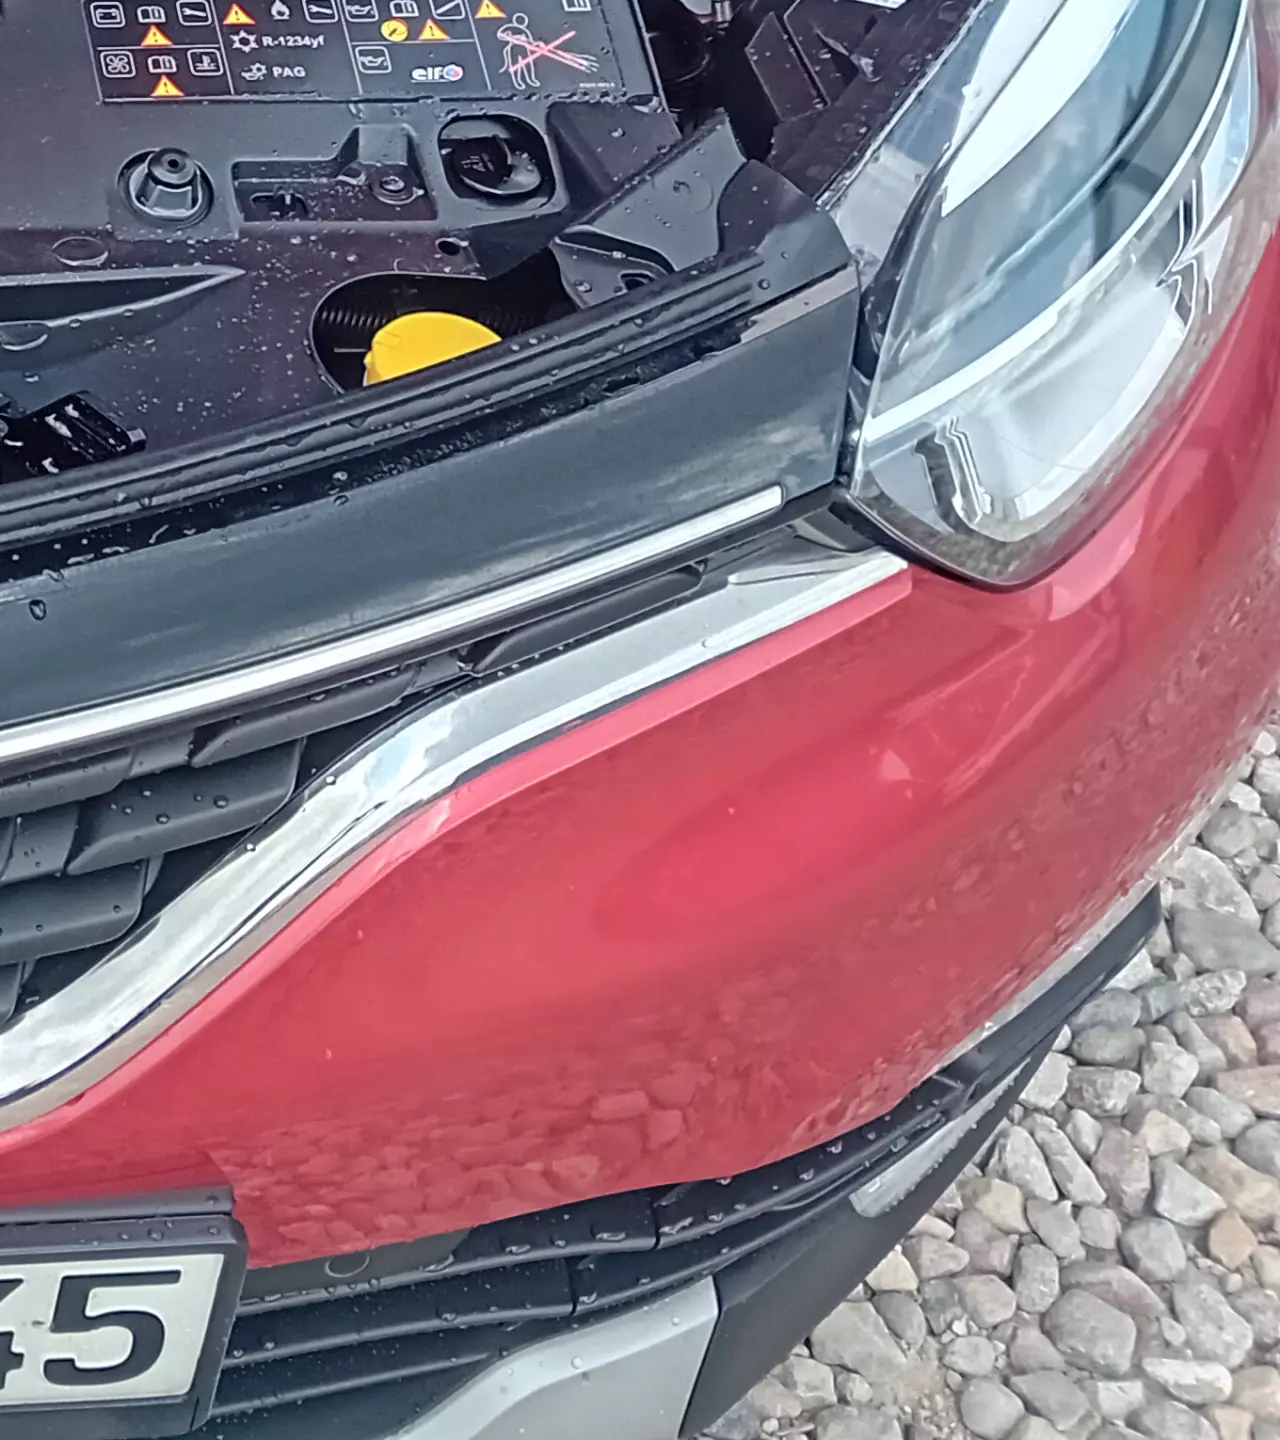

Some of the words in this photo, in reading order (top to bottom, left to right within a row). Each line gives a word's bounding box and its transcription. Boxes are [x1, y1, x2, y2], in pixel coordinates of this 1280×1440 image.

[261, 35, 325, 49] R-1234yf
[271, 65, 307, 79] PAG
[411, 64, 445, 82] elf
